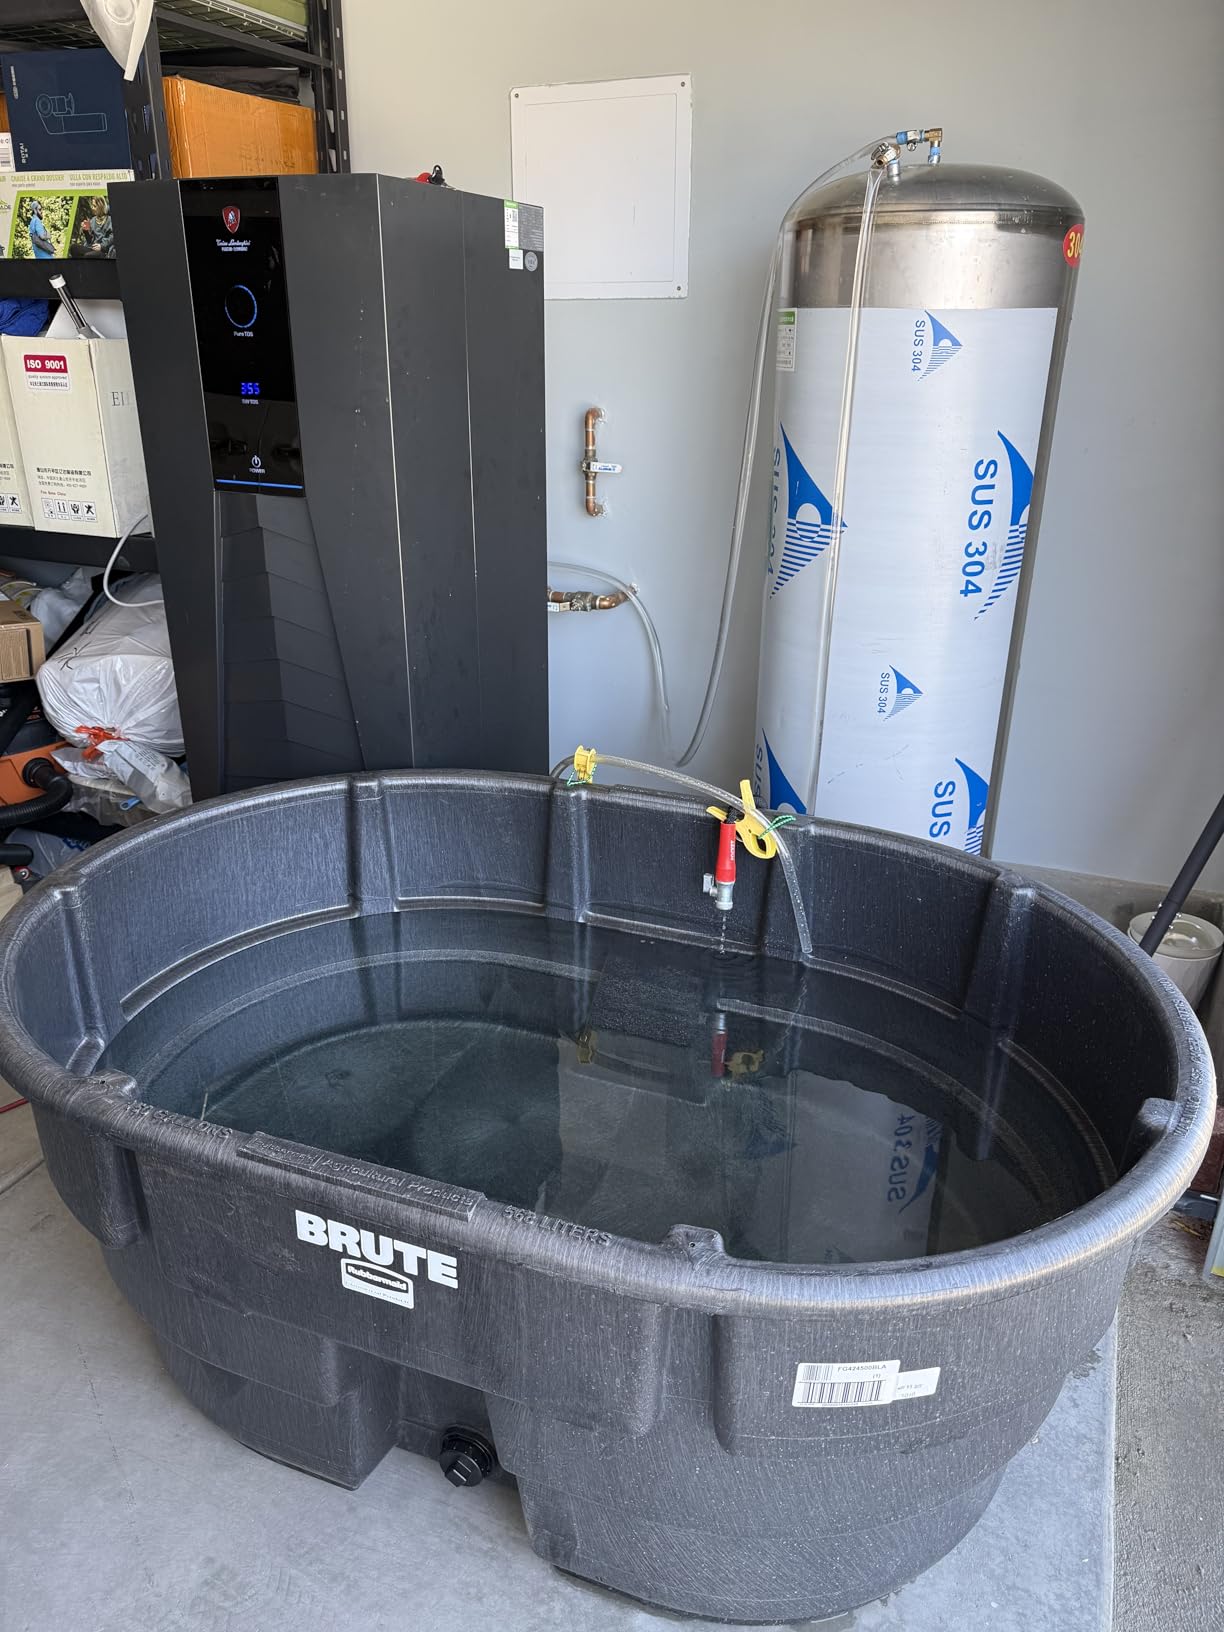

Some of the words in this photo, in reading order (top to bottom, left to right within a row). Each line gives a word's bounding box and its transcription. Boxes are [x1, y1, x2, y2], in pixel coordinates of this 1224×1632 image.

[913, 319, 926, 347] SUS
[27, 360, 41, 369] ISO
[45, 360, 65, 369] 9001
[911, 350, 923, 373] 304
[241, 383, 260, 394] 355
[968, 458, 998, 531] SUS
[960, 541, 988, 597] 304
[879, 672, 891, 694] SUS
[877, 696, 888, 714] 304
[929, 780, 956, 838] SUS
[322, 1158, 406, 1187] Agricultural
[407, 1180, 474, 1206] Products
[539, 1215, 613, 1247] LITERS
[295, 1209, 459, 1289] BRUTE
[347, 1265, 407, 1291] Rubbermaid
